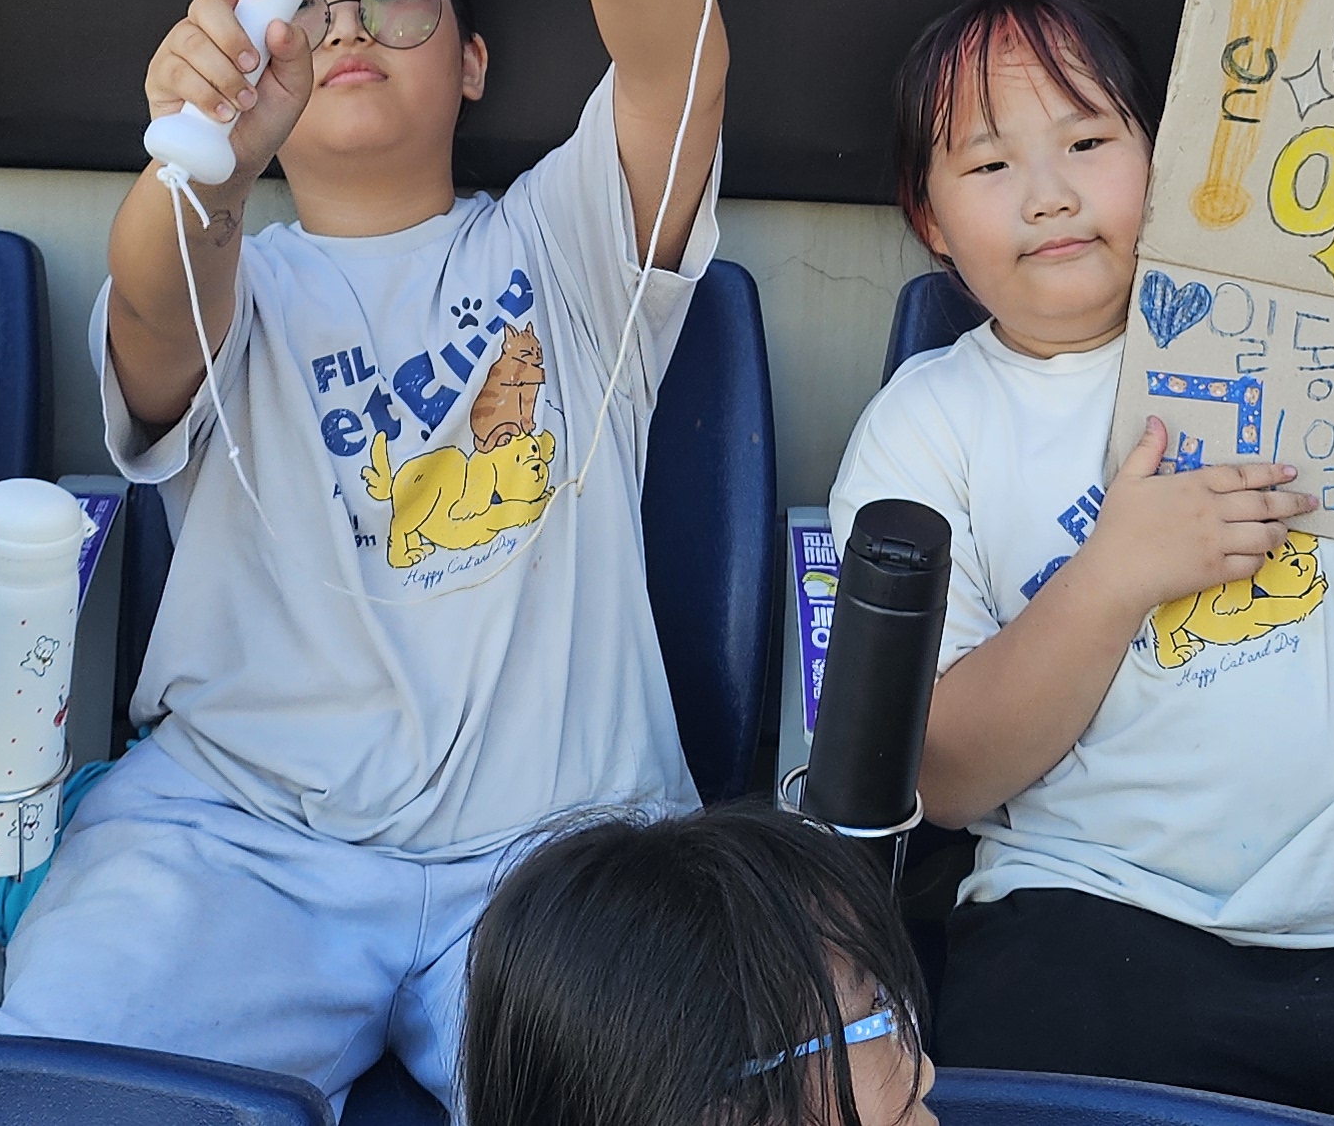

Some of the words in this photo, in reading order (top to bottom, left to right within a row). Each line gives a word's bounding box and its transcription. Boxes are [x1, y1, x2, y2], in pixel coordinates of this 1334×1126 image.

[1176, 662, 1218, 689] Happy
[1219, 652, 1244, 672] Cat
[1247, 643, 1271, 664] and
[1274, 631, 1301, 655] Dog
